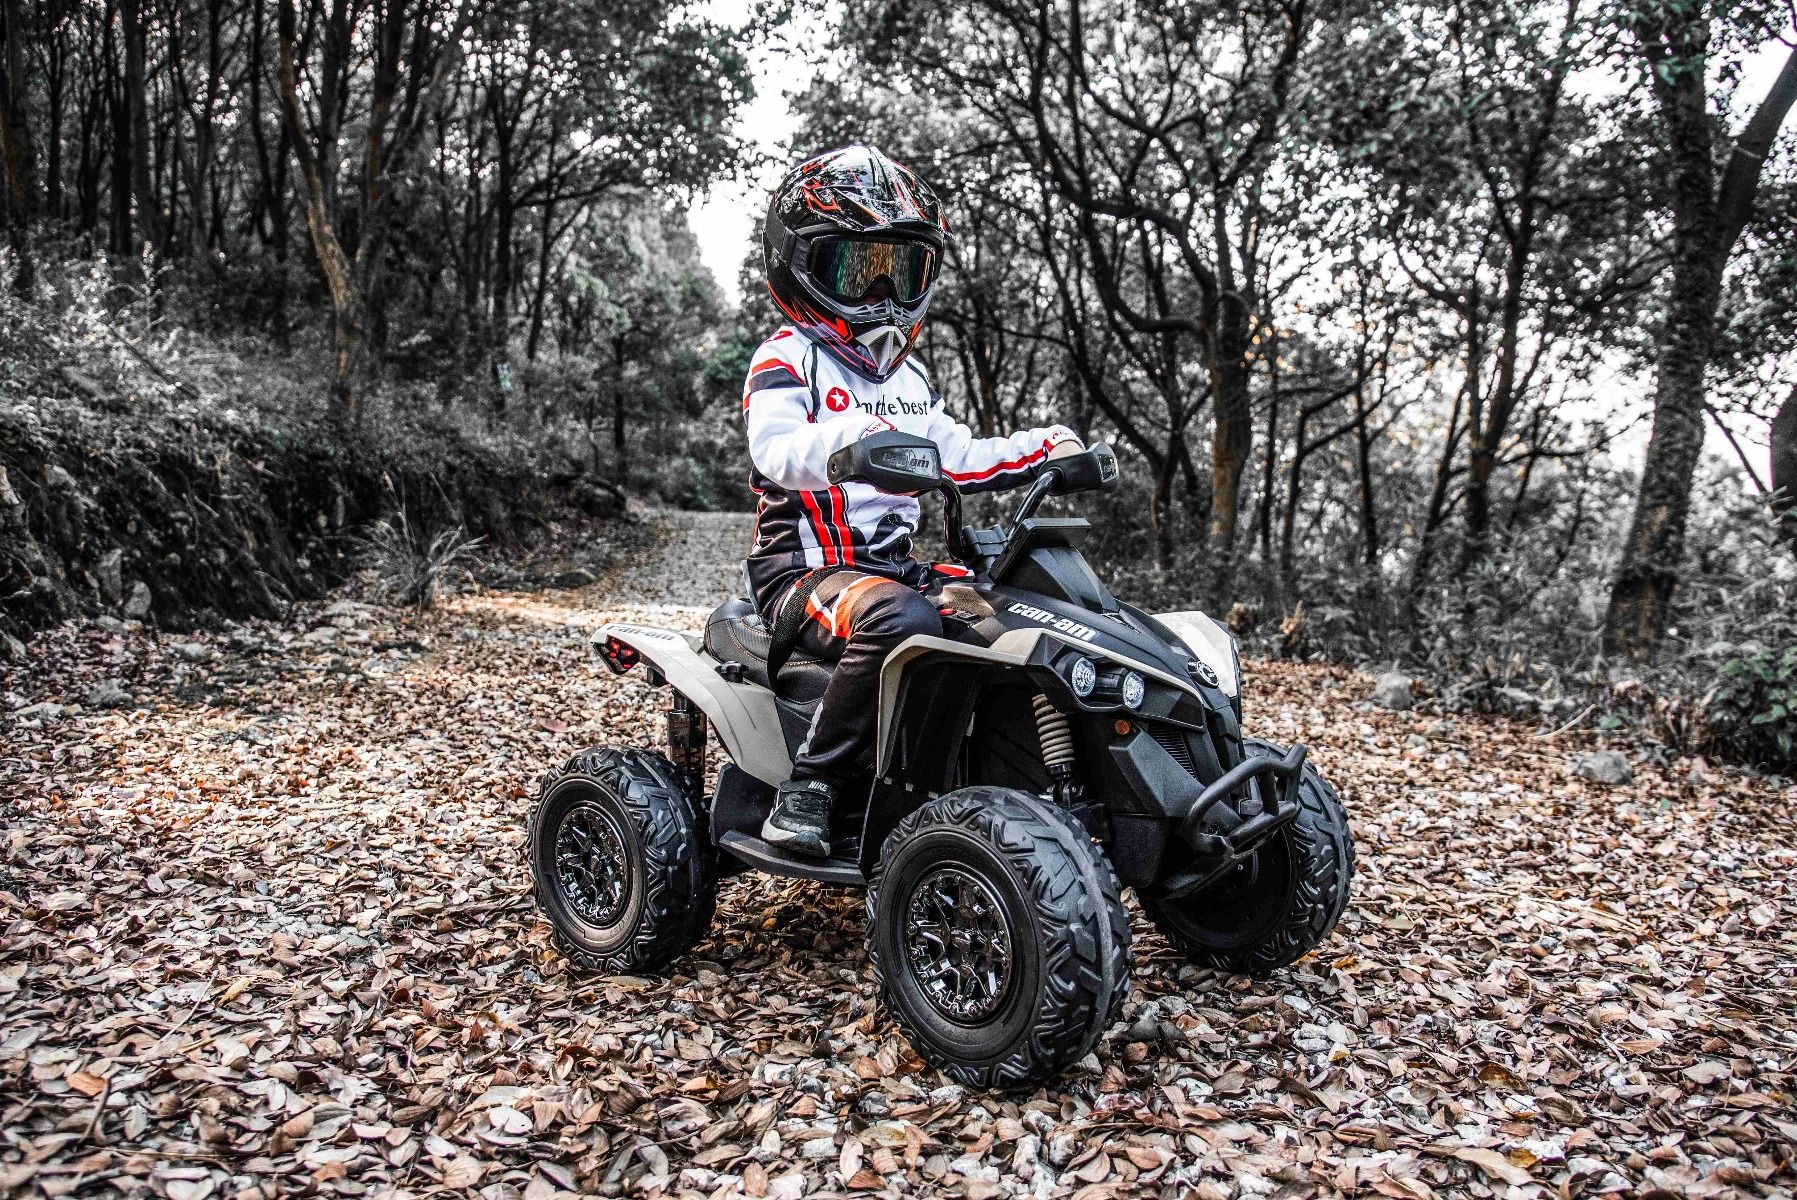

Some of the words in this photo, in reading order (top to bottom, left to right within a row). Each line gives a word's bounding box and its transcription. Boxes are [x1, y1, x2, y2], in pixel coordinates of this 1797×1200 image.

[896, 396, 928, 416] best
[1007, 602, 1096, 640] can-am
[808, 780, 829, 792] NIKE
